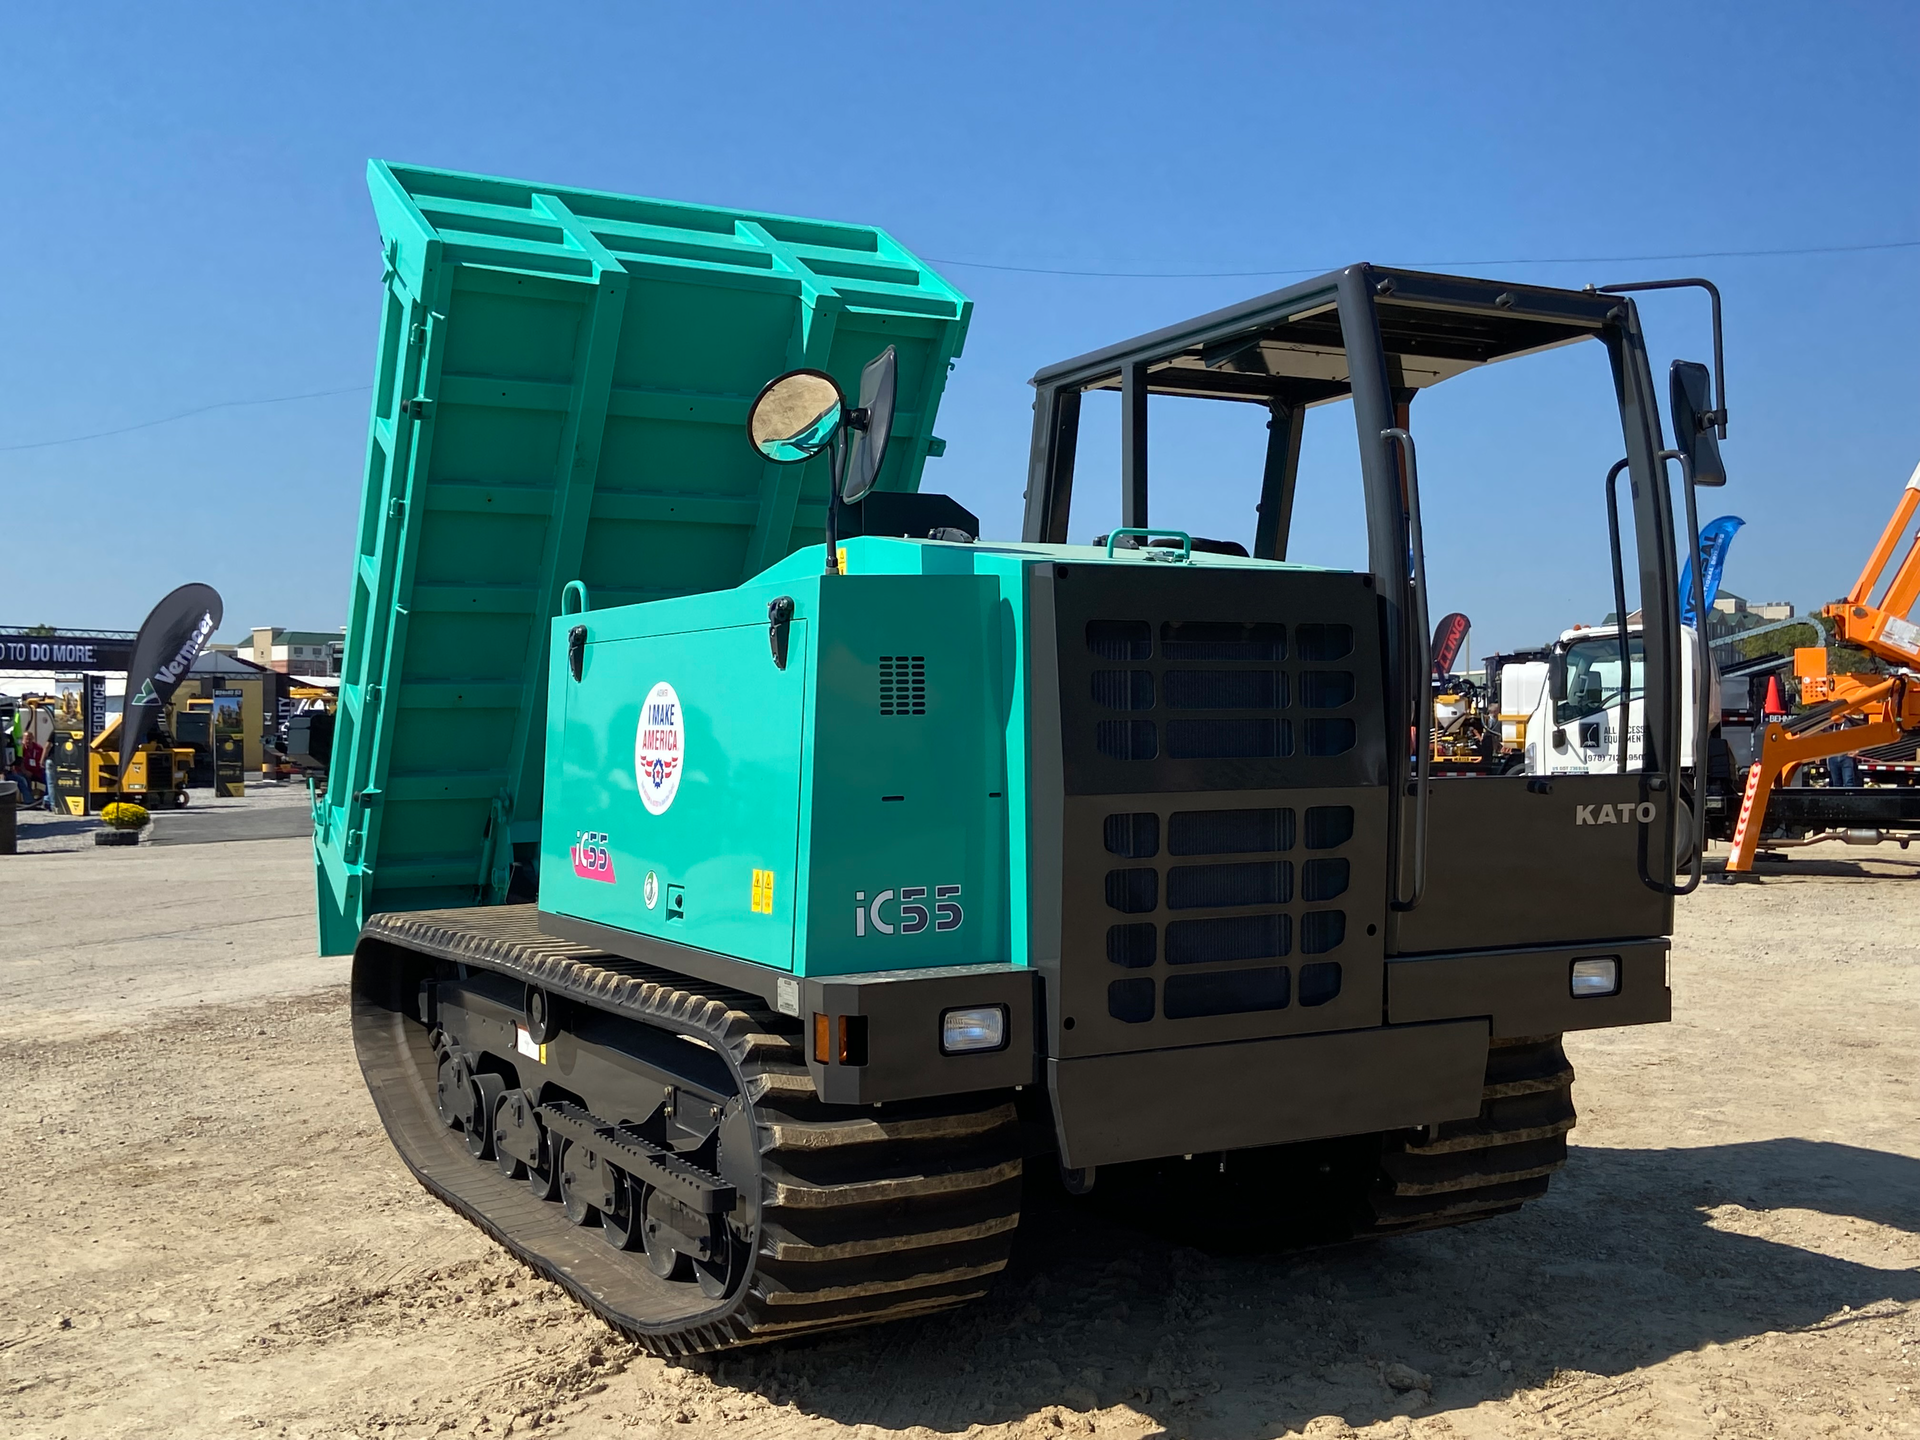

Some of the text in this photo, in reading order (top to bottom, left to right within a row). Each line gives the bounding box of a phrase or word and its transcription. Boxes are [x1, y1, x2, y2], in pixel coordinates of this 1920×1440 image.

[7, 643, 26, 661] TO
[30, 643, 50, 662] DO
[154, 612, 214, 684] Vermeer
[1439, 615, 1466, 673] LLING
[92, 682, 106, 738] FIDENCE
[648, 703, 675, 726] I MAKE
[642, 729, 678, 751] AMERICA
[1603, 726, 1617, 735] ALL
[1575, 802, 1656, 826] KATO
[574, 829, 609, 872] iC55
[855, 884, 964, 938] iC55
